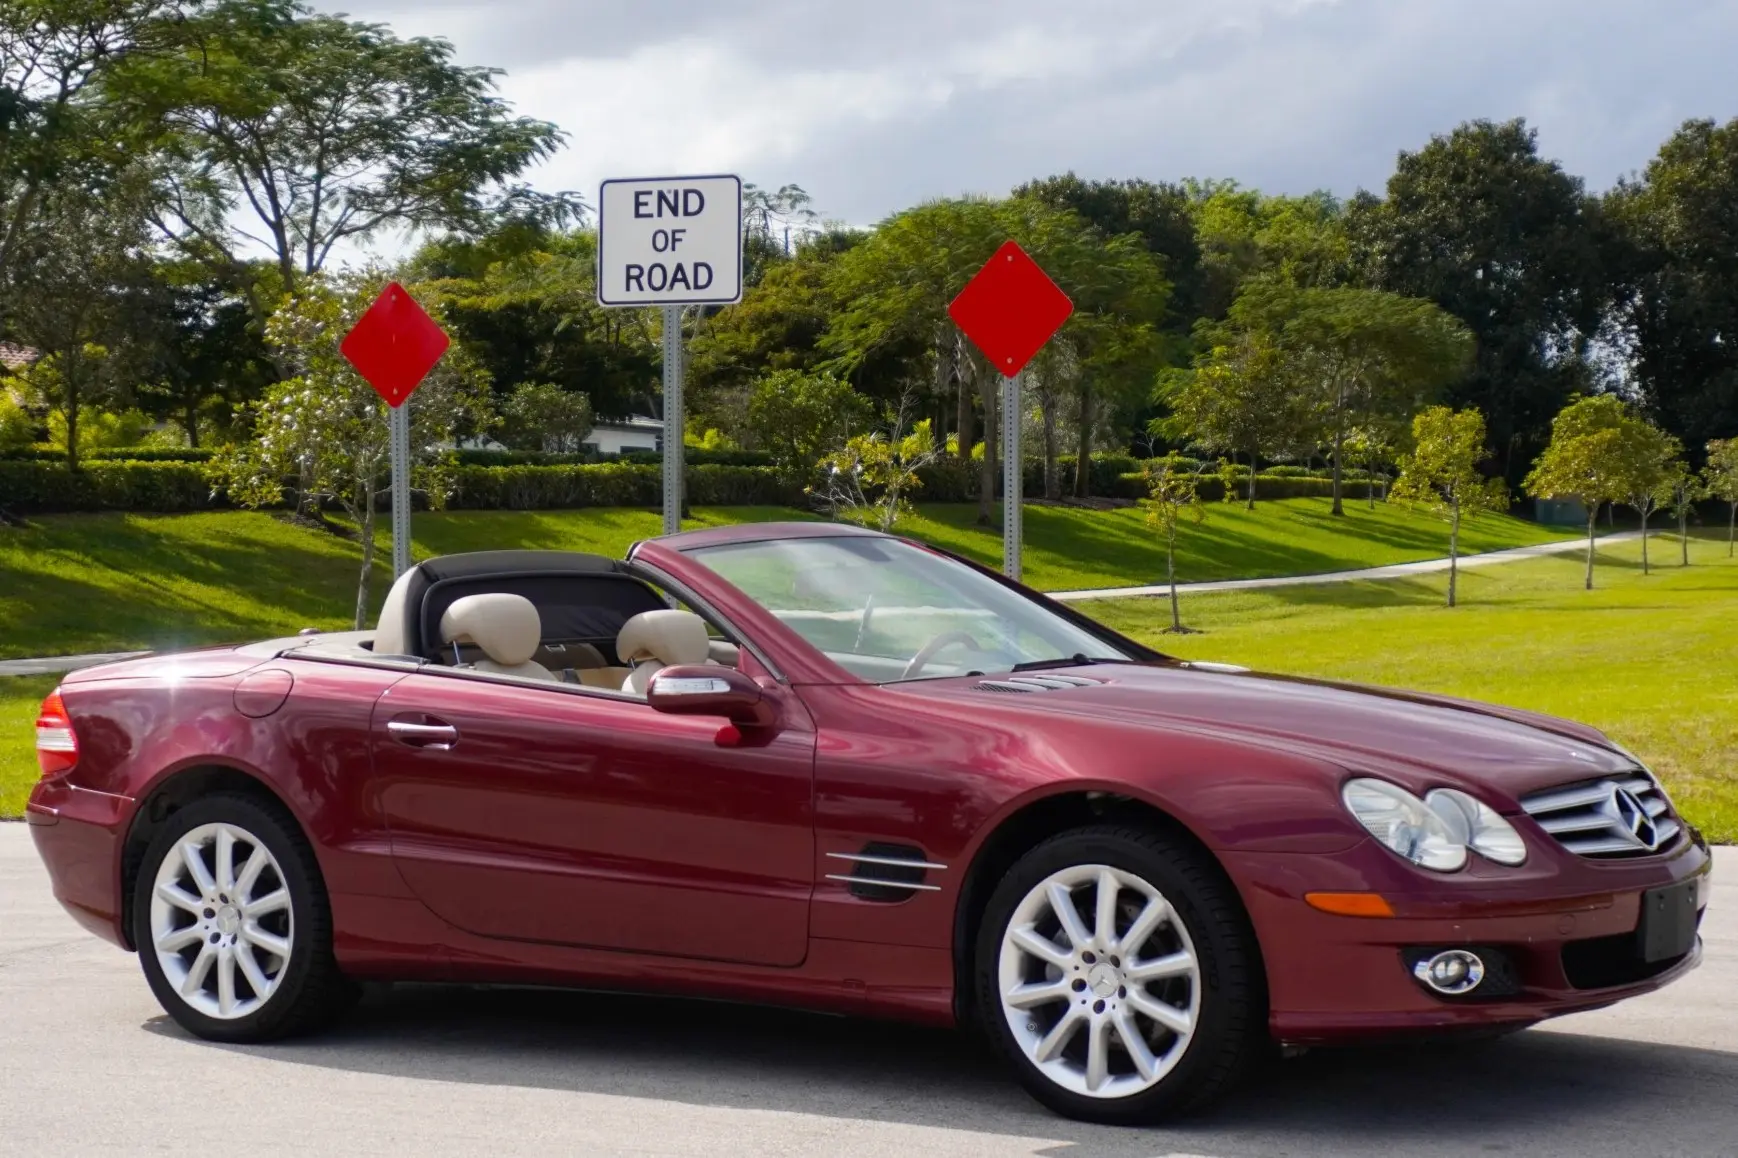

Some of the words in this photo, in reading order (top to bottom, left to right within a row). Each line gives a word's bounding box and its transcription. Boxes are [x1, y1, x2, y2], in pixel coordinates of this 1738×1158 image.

[634, 188, 705, 219] END
[651, 228, 686, 253] OF
[625, 261, 713, 293] ROAD
